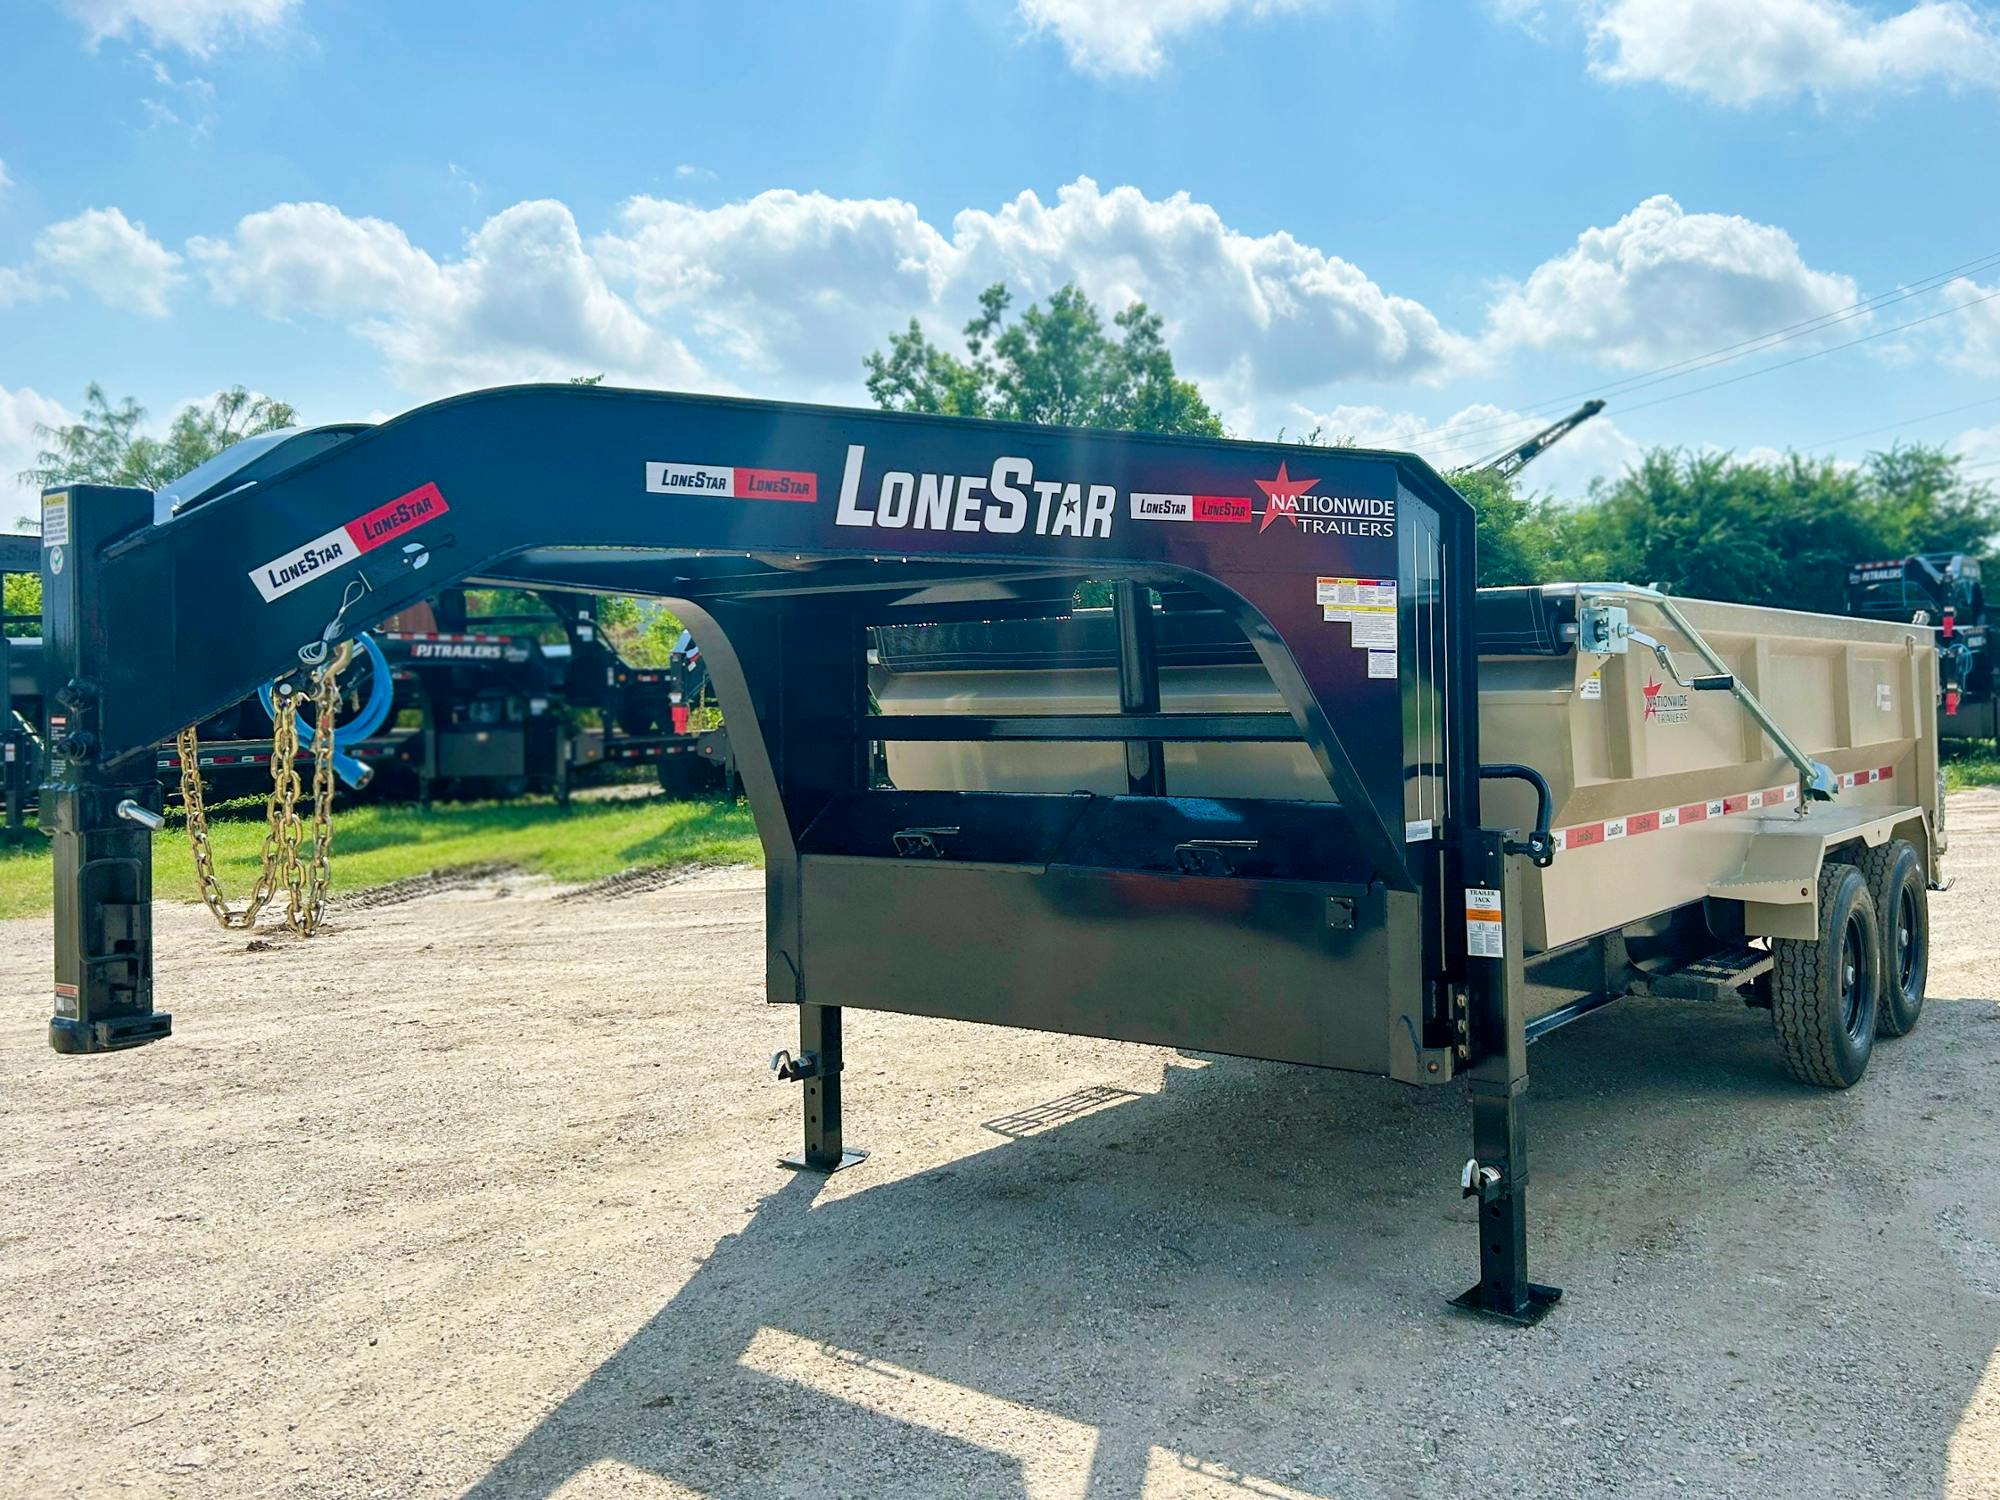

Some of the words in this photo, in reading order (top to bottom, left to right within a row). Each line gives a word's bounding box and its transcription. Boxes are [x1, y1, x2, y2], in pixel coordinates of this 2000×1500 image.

[835, 444, 1117, 538] LONESTAR
[1271, 493, 1395, 517] NATIONWIDE
[1297, 519, 1394, 537] TRAILERS
[1647, 695, 1688, 708] NATIONWIDE
[1657, 713, 1688, 723] TRAILERS
